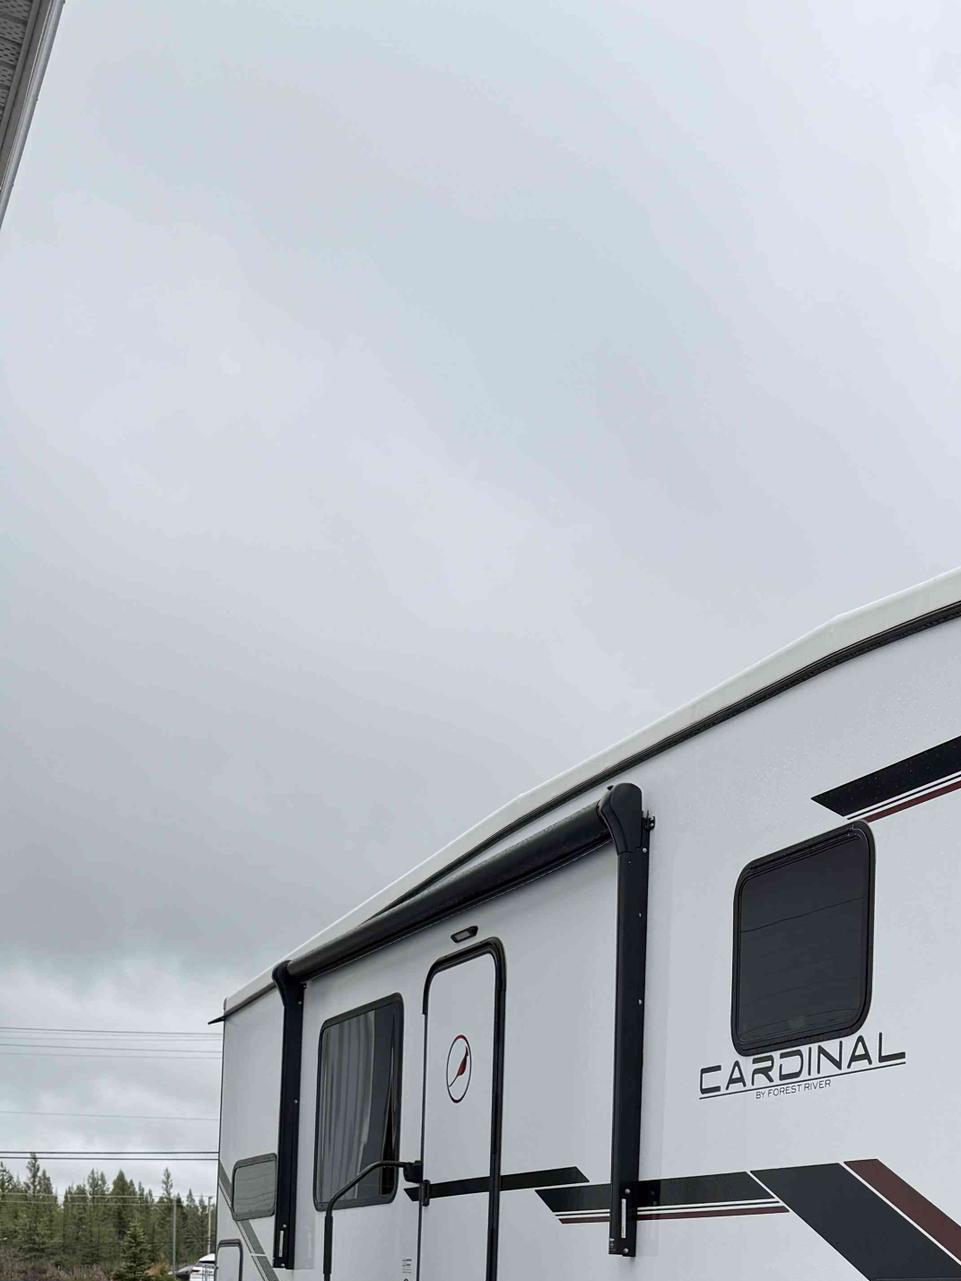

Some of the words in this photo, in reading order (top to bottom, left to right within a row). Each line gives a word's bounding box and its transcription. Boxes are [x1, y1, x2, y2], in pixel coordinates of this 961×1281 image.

[699, 1031, 906, 1096] CARDINAL
[755, 1089, 767, 1100] BY
[767, 1083, 803, 1098] FOREST
[803, 1079, 832, 1092] RIVER
